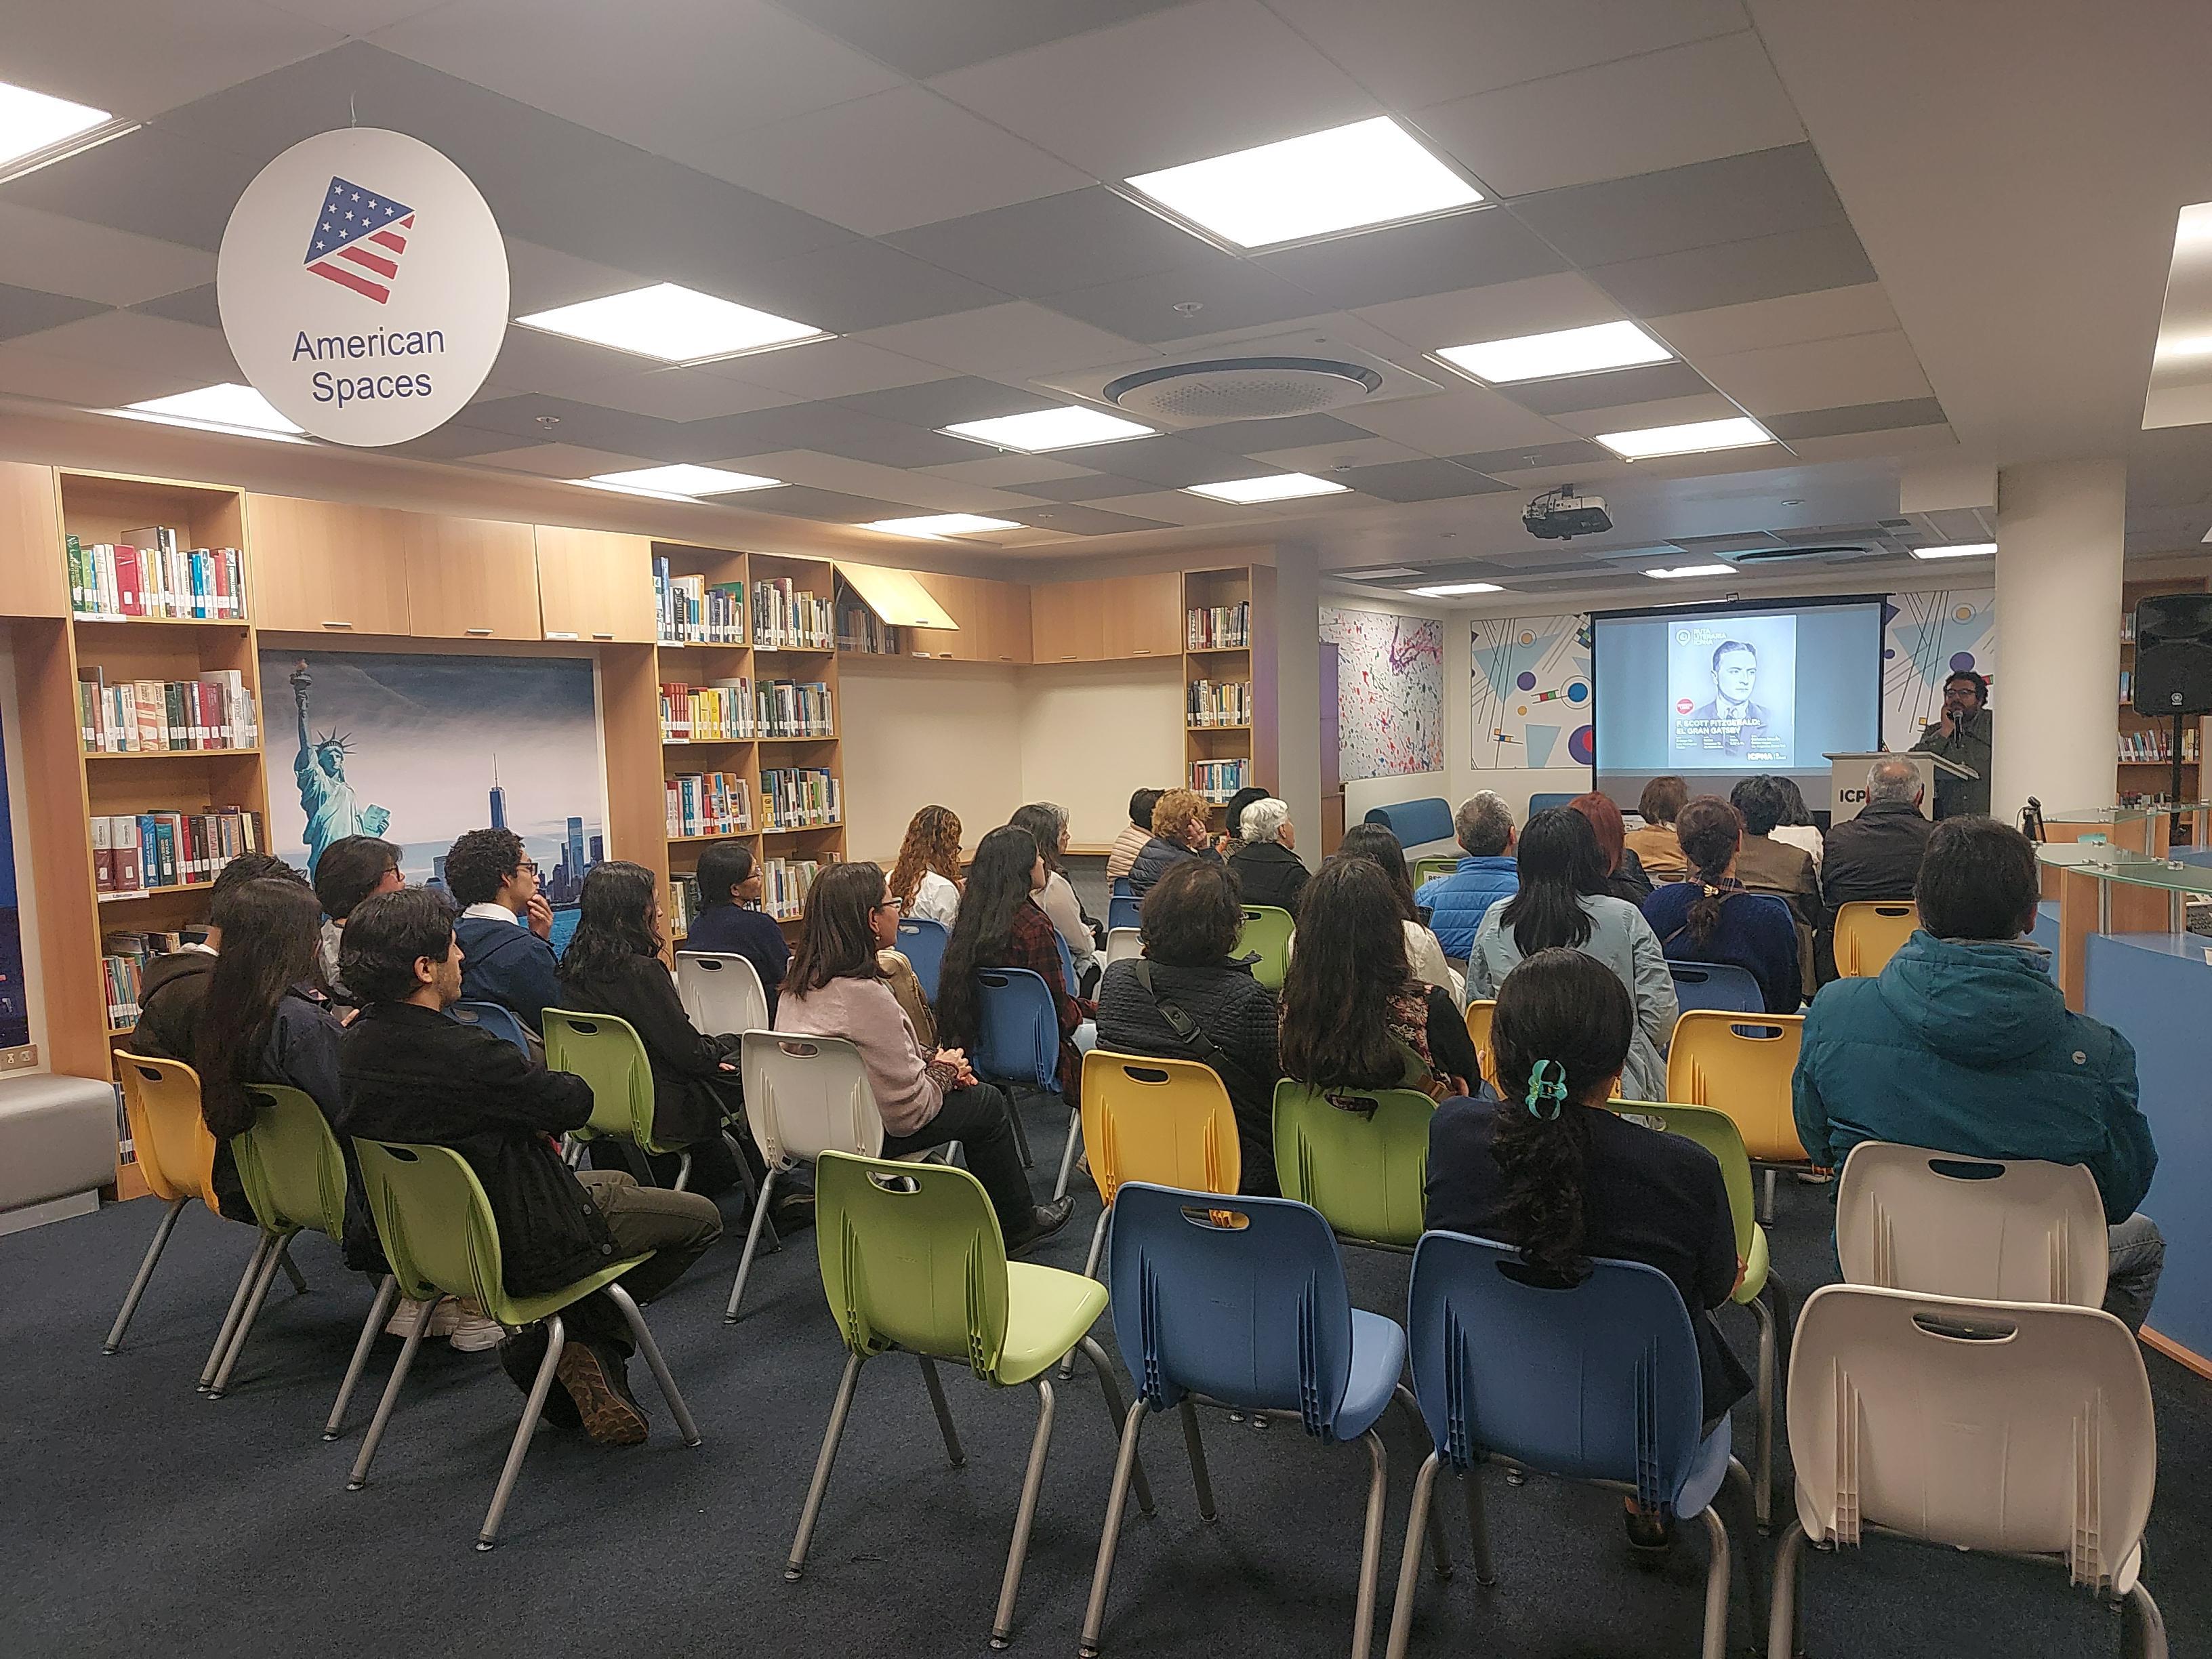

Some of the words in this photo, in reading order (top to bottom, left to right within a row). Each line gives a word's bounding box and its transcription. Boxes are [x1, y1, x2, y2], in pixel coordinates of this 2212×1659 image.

[291, 326, 445, 361] American
[312, 371, 432, 409] Spaces
[1676, 727, 1686, 735] EL
[1687, 726, 1709, 735] GRAN
[1711, 726, 1741, 735] GATSBY
[1684, 719, 1708, 727] SCOTT
